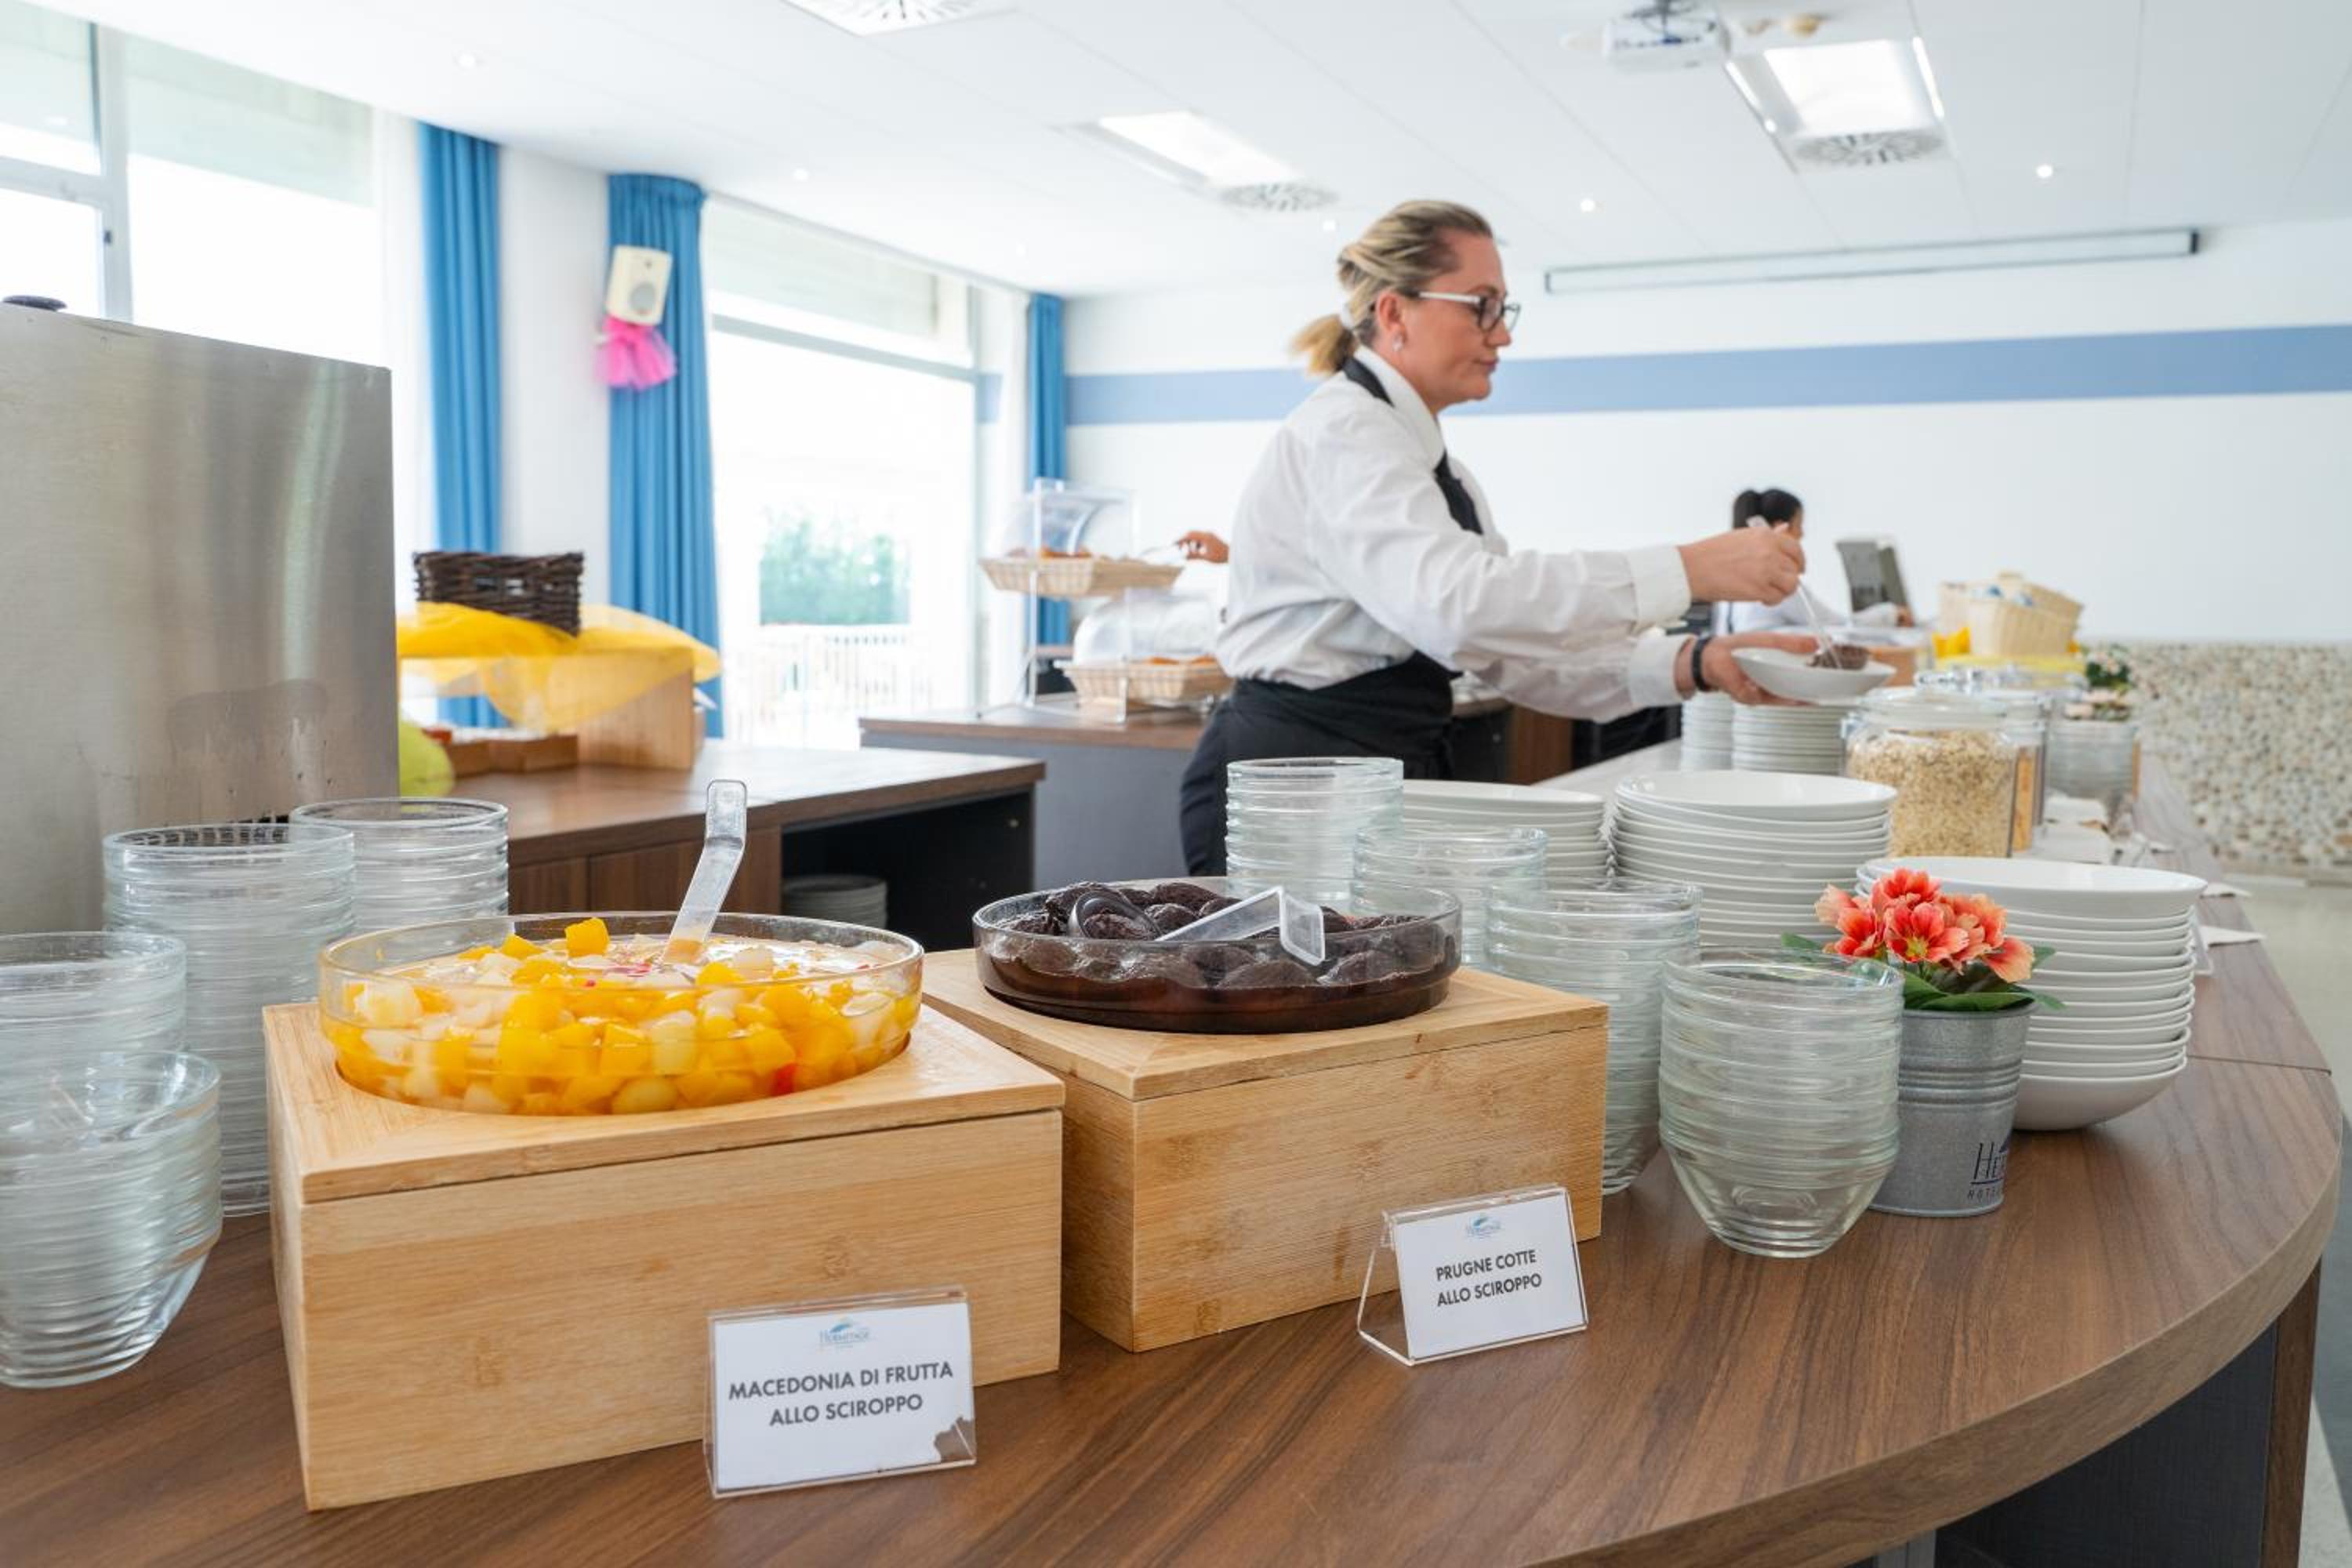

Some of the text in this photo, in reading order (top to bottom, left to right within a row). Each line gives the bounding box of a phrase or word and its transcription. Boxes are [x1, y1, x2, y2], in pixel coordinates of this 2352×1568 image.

[1436, 1250, 1537, 1281] PRUGNE COTTE
[1437, 1273, 1542, 1306] ALLO SCIROPPO
[729, 1361, 953, 1399] MACEDONIA DI FRUTTA
[769, 1394, 923, 1426] ALLO SCIROPPO
